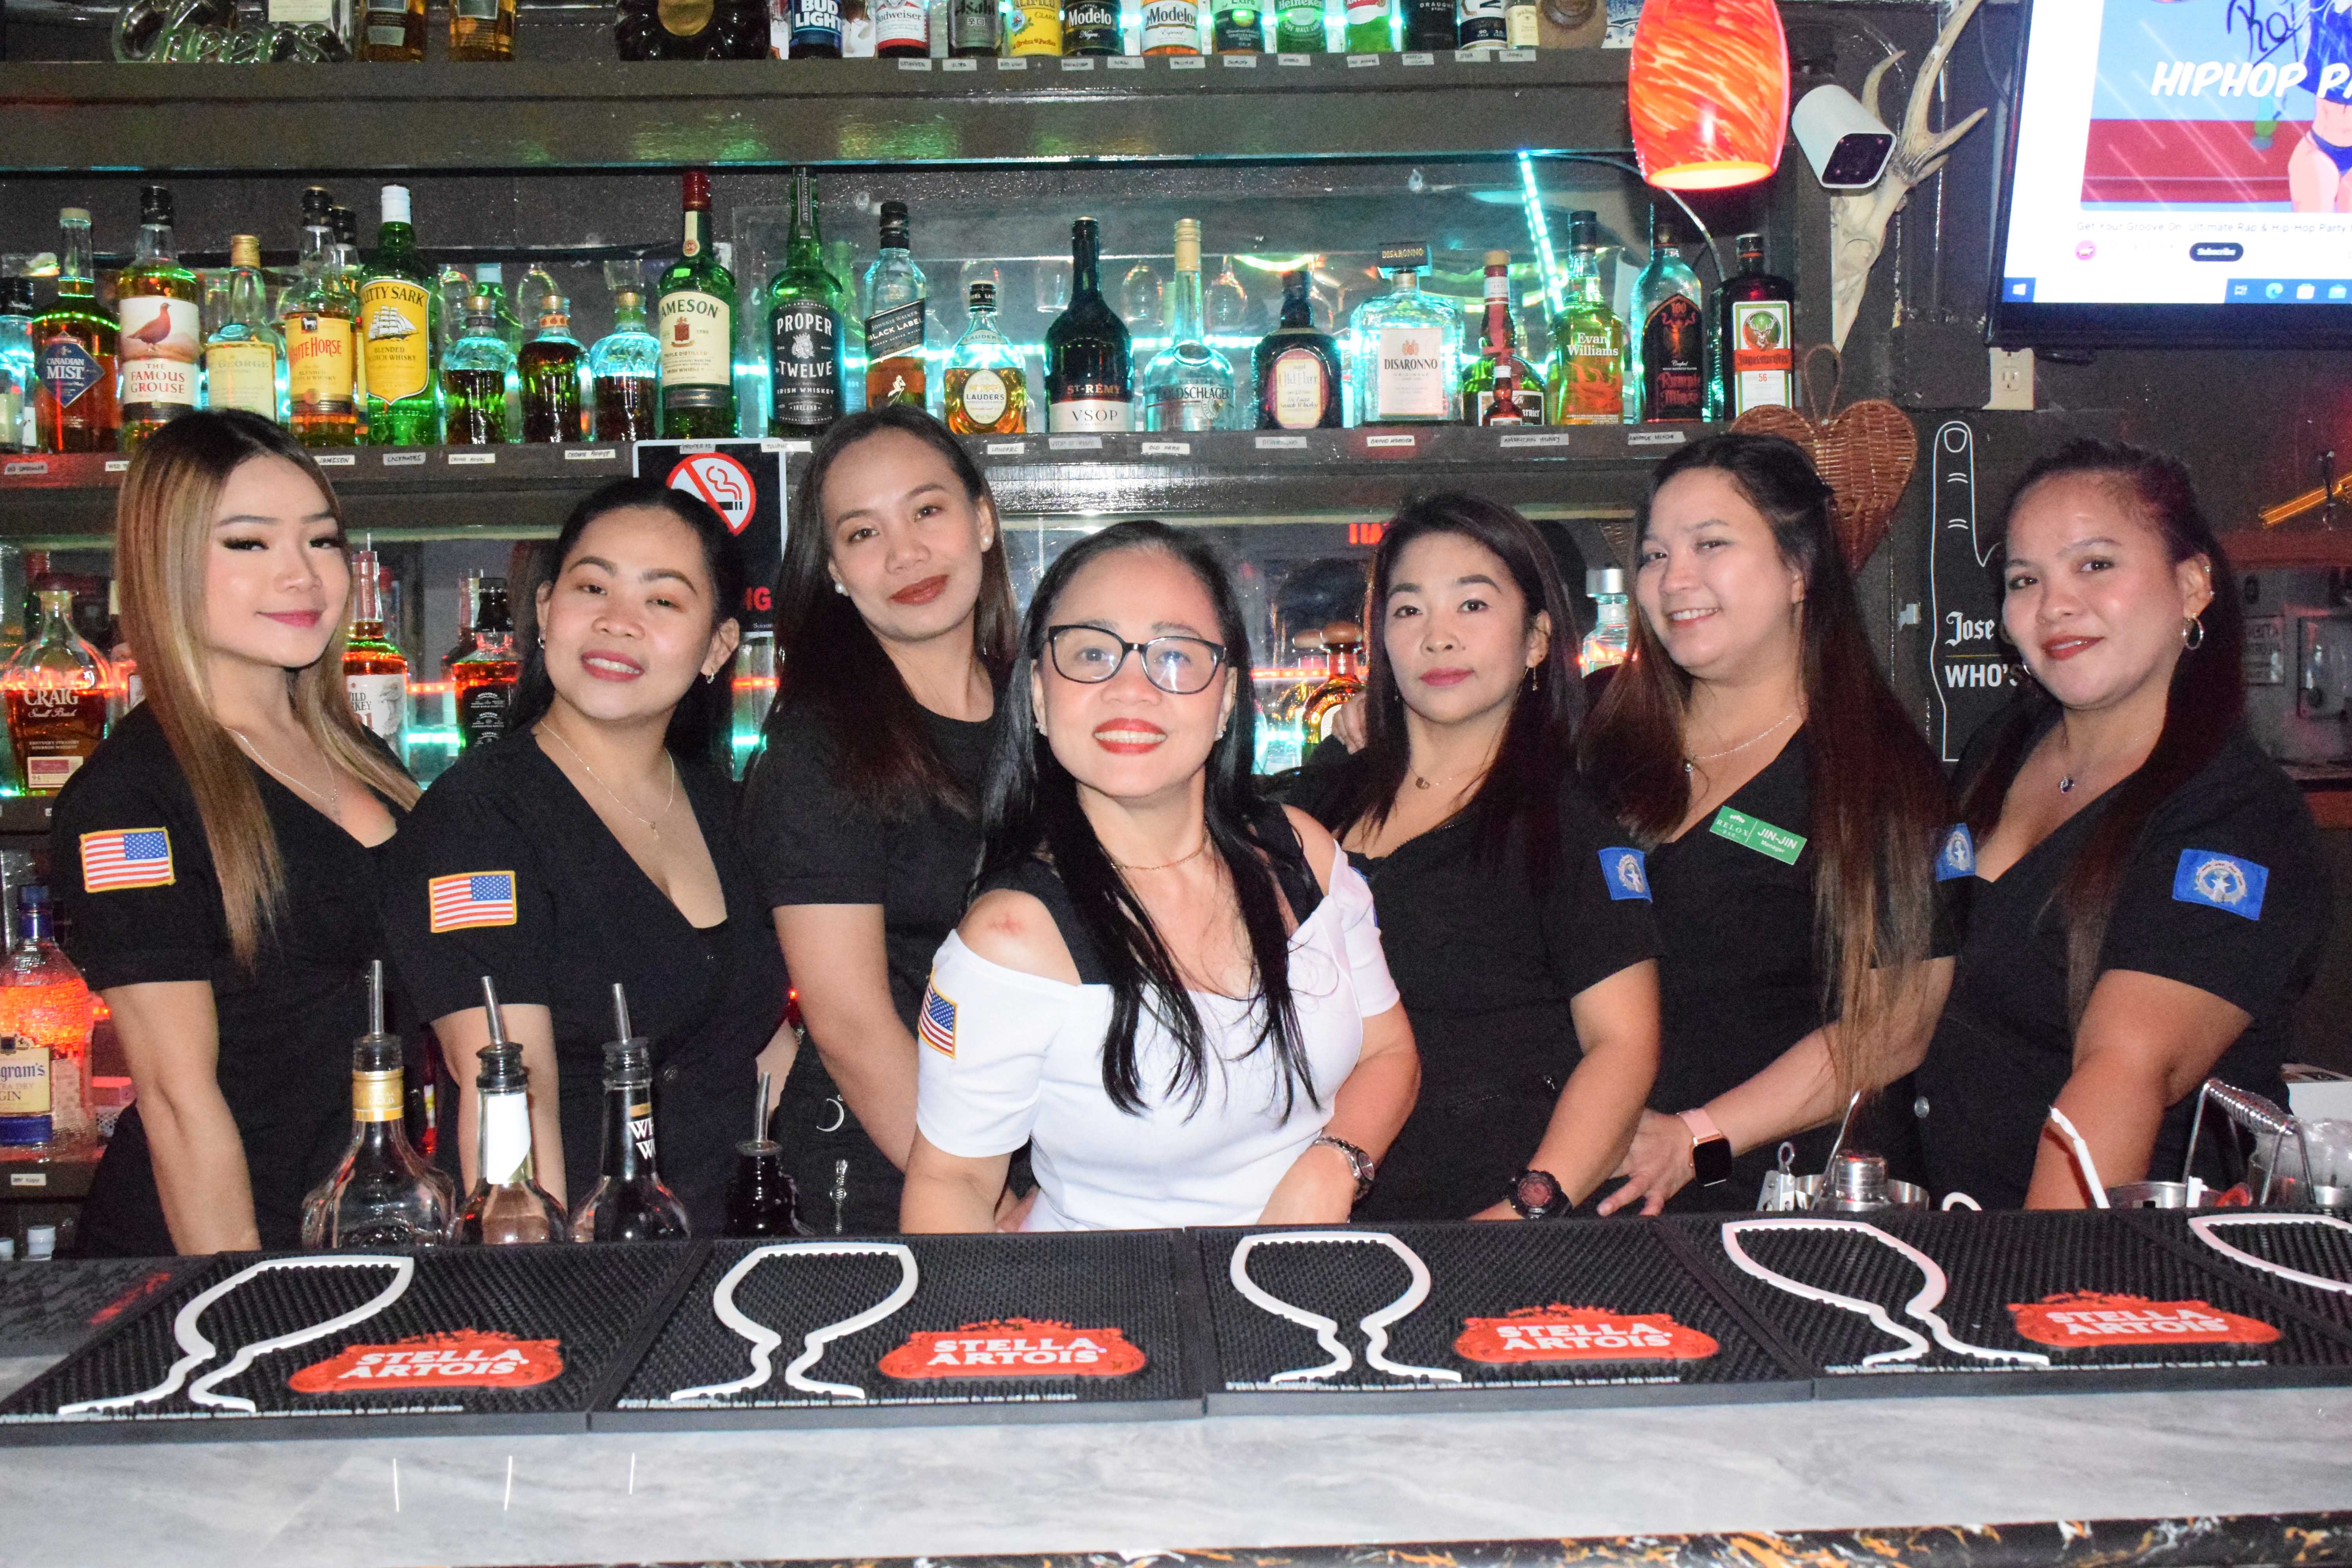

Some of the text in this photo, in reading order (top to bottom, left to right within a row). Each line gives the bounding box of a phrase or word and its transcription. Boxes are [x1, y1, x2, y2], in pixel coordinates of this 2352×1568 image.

[802, 0, 838, 15] BUD
[1150, 7, 1193, 23] Modelo
[795, 11, 842, 32] LIGHT
[877, 11, 922, 24] Budweiser
[1069, 9, 1111, 27] Modelo
[2150, 61, 2308, 98] HIPHOP
[2077, 222, 2095, 231] Get
[2100, 222, 2123, 231] Your
[2127, 222, 2164, 231] Groove
[2189, 222, 2233, 231] Ultimate
[2238, 223, 2257, 232] Rap
[2272, 223, 2315, 232] Hip-Hop
[2319, 223, 2346, 234] Party
[1382, 248, 1424, 259] DISARONNO
[391, 286, 425, 307] SARK
[661, 299, 719, 318] AMESON
[777, 312, 832, 337] PROPER
[867, 318, 922, 341] BLACK LABEL
[1577, 332, 1608, 344] Evan
[311, 336, 342, 357] HORSE
[1566, 344, 1619, 356] Williams
[46, 366, 85, 379] MIST
[779, 360, 832, 378] TWELVE
[1384, 358, 1438, 371] DISARONNO
[131, 370, 185, 383] FAMOUS
[1758, 373, 1768, 382] 56
[131, 382, 185, 394] GROUSE
[1071, 409, 1118, 421] VSOP
[1945, 612, 1995, 646] Jose
[24, 688, 79, 708] CRAIG
[350, 692, 366, 702] ILD
[1757, 828, 1798, 849] JIN-JIN
[1760, 840, 1785, 853] Manager
[2046, 1309, 2212, 1323] STELLA
[1496, 1323, 1663, 1338] STELLA
[2066, 1319, 2229, 1336] ARTOIS
[934, 1338, 1098, 1352] STELLA
[1503, 1334, 1671, 1350] ARTOIS
[356, 1348, 523, 1366] STELLA
[926, 1350, 1100, 1366] ARTOIS
[338, 1360, 518, 1379] ARTOIS
